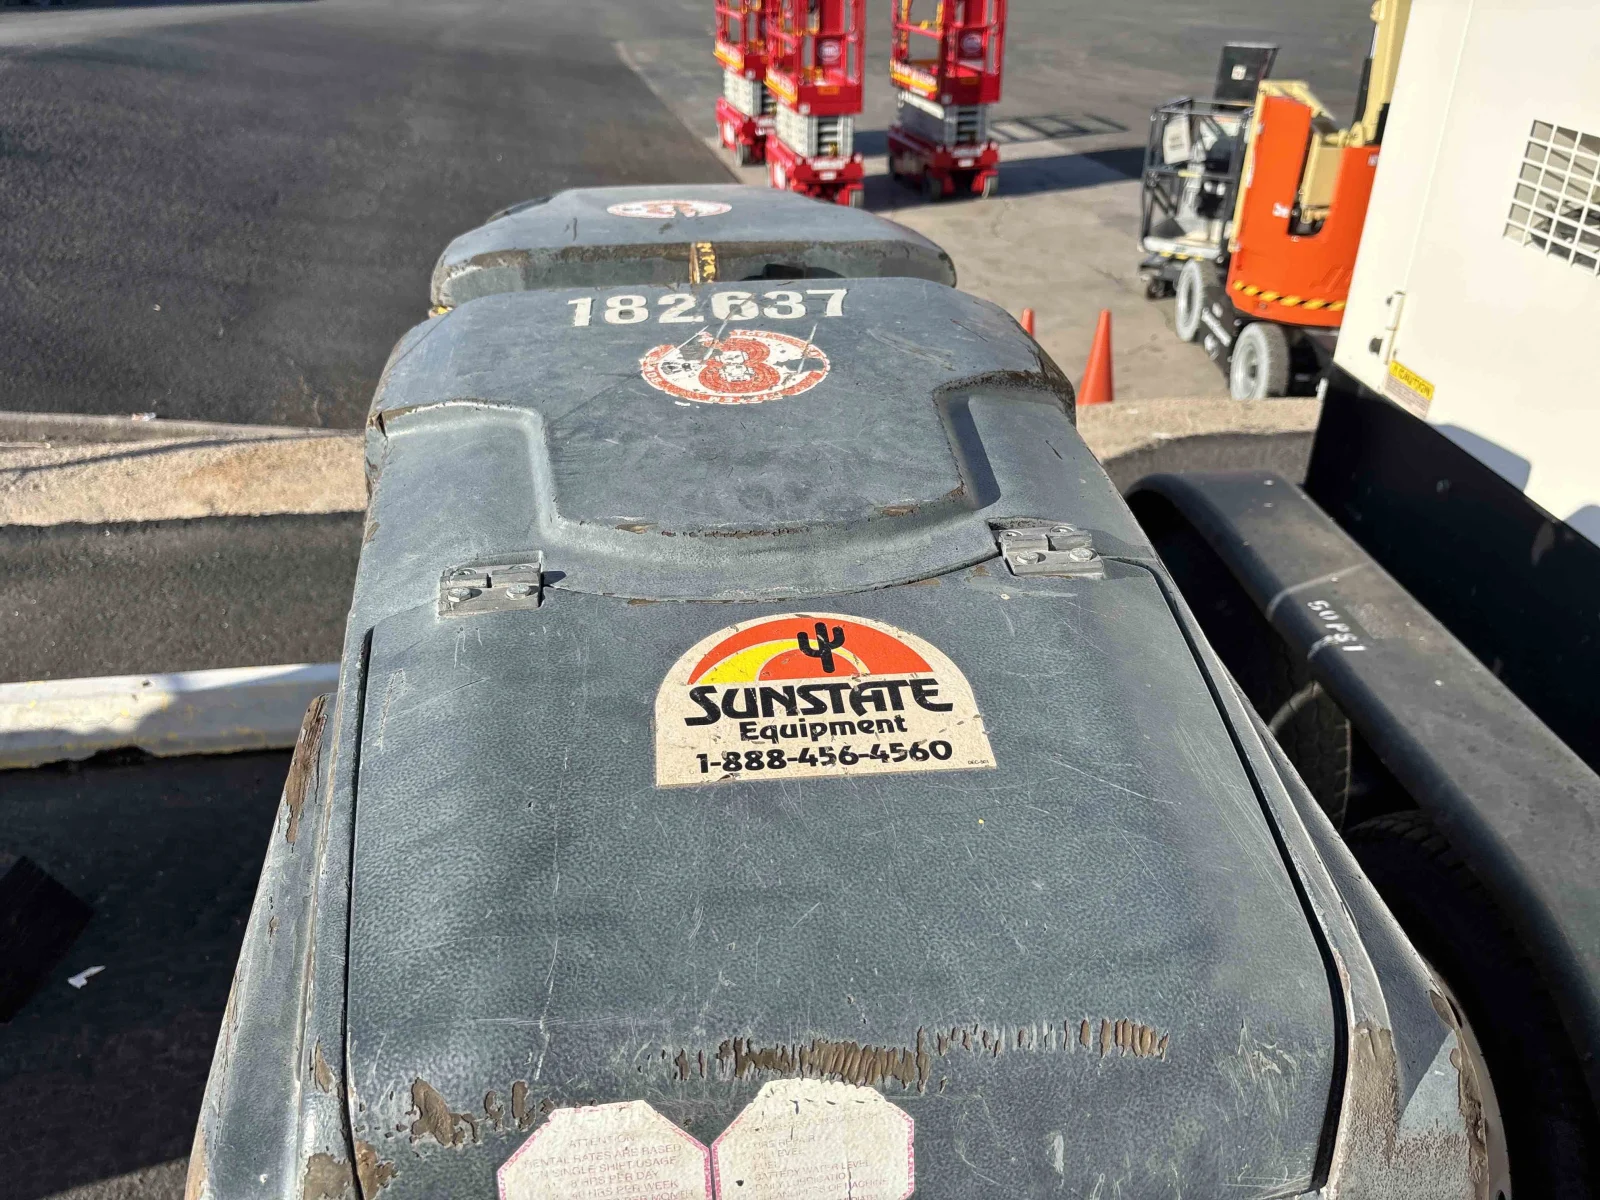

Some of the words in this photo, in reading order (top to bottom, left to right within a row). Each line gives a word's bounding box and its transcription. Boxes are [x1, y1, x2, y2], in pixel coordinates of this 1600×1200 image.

[567, 288, 848, 327] 182637
[684, 678, 954, 727] SUNSTATE
[739, 714, 908, 744] Equipment
[696, 739, 953, 774] 1-888-456-4560
[636, 1170, 660, 1180] DAY
[644, 1179, 679, 1192] WEEK
